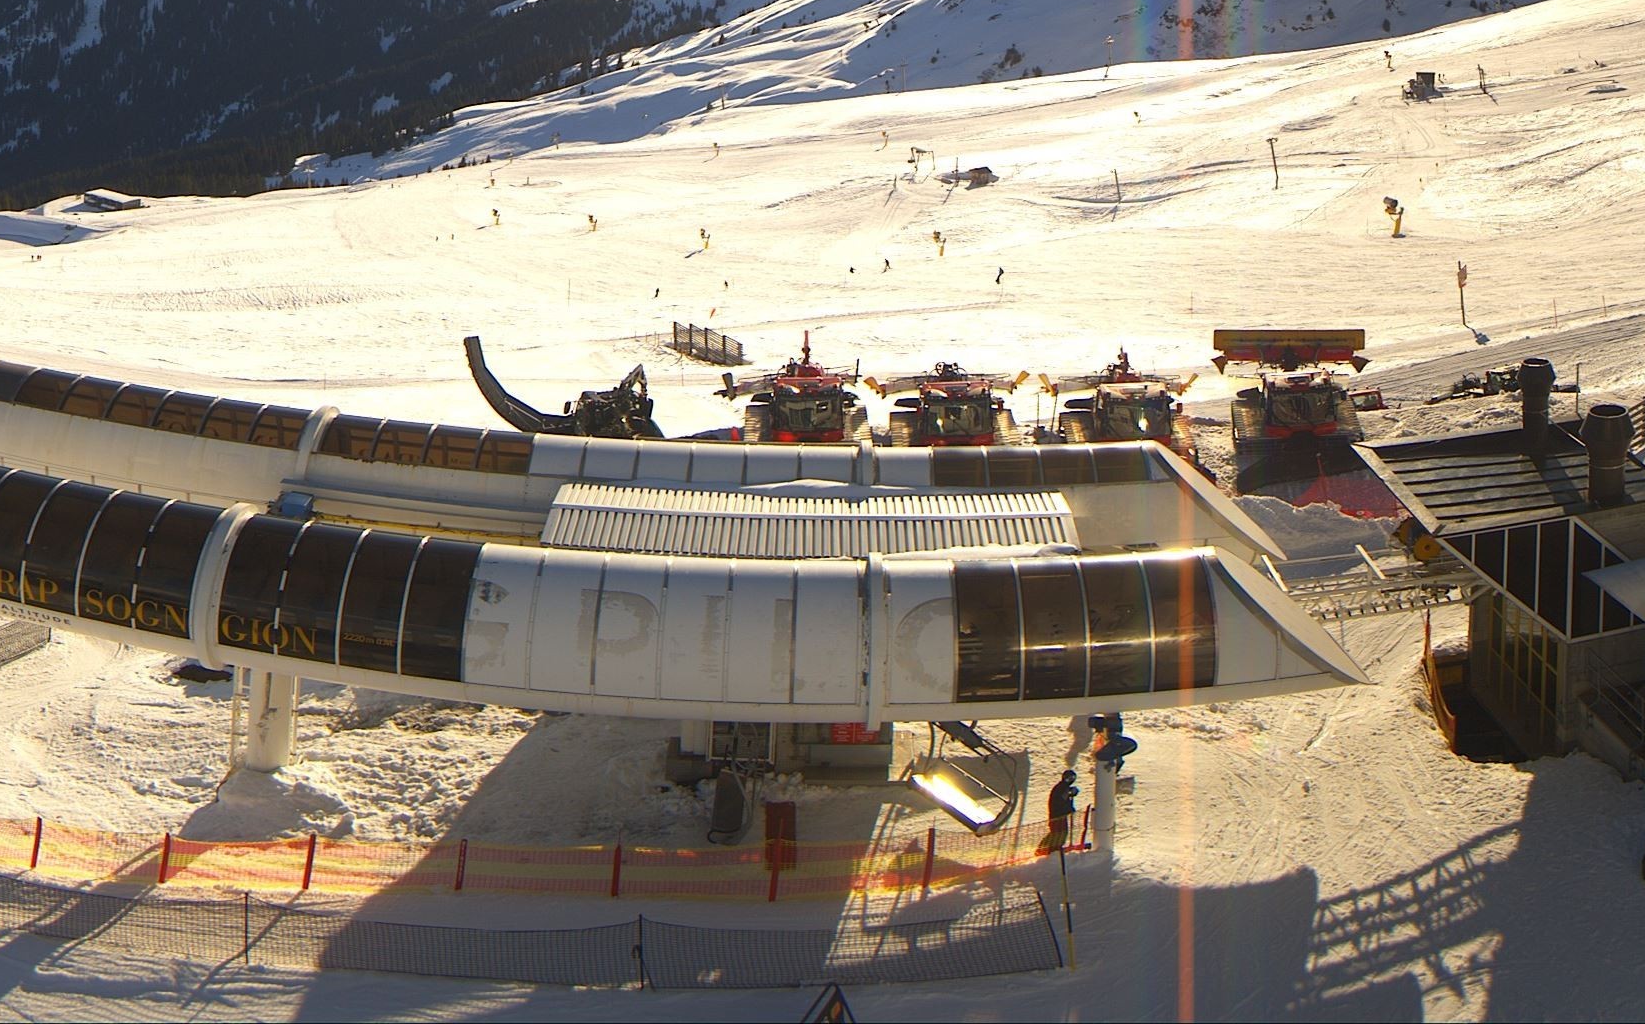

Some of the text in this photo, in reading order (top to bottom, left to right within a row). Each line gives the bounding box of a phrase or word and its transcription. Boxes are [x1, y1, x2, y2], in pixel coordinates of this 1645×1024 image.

[1, 604, 72, 626] ALTITUDE
[85, 589, 190, 634] SOGN
[221, 614, 317, 656] GION
